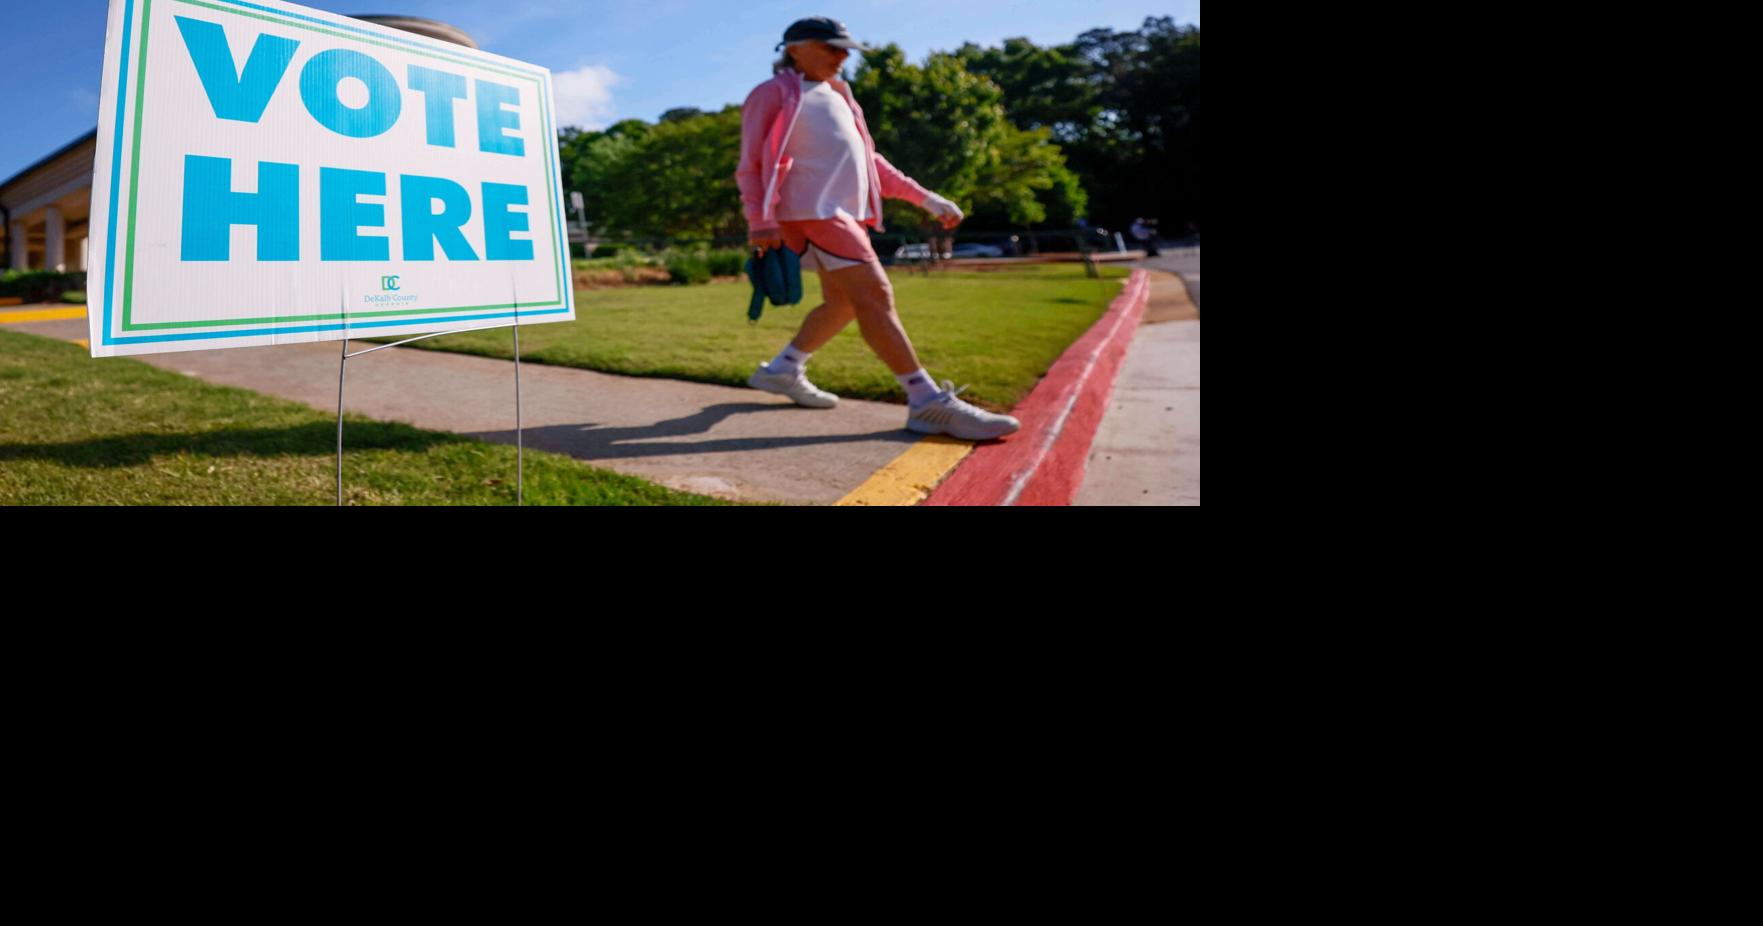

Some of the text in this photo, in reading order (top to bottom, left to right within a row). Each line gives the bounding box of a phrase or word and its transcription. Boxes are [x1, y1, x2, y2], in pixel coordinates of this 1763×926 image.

[174, 16, 525, 156] VOTE
[181, 155, 534, 261] HERE
[381, 275, 401, 291] DC
